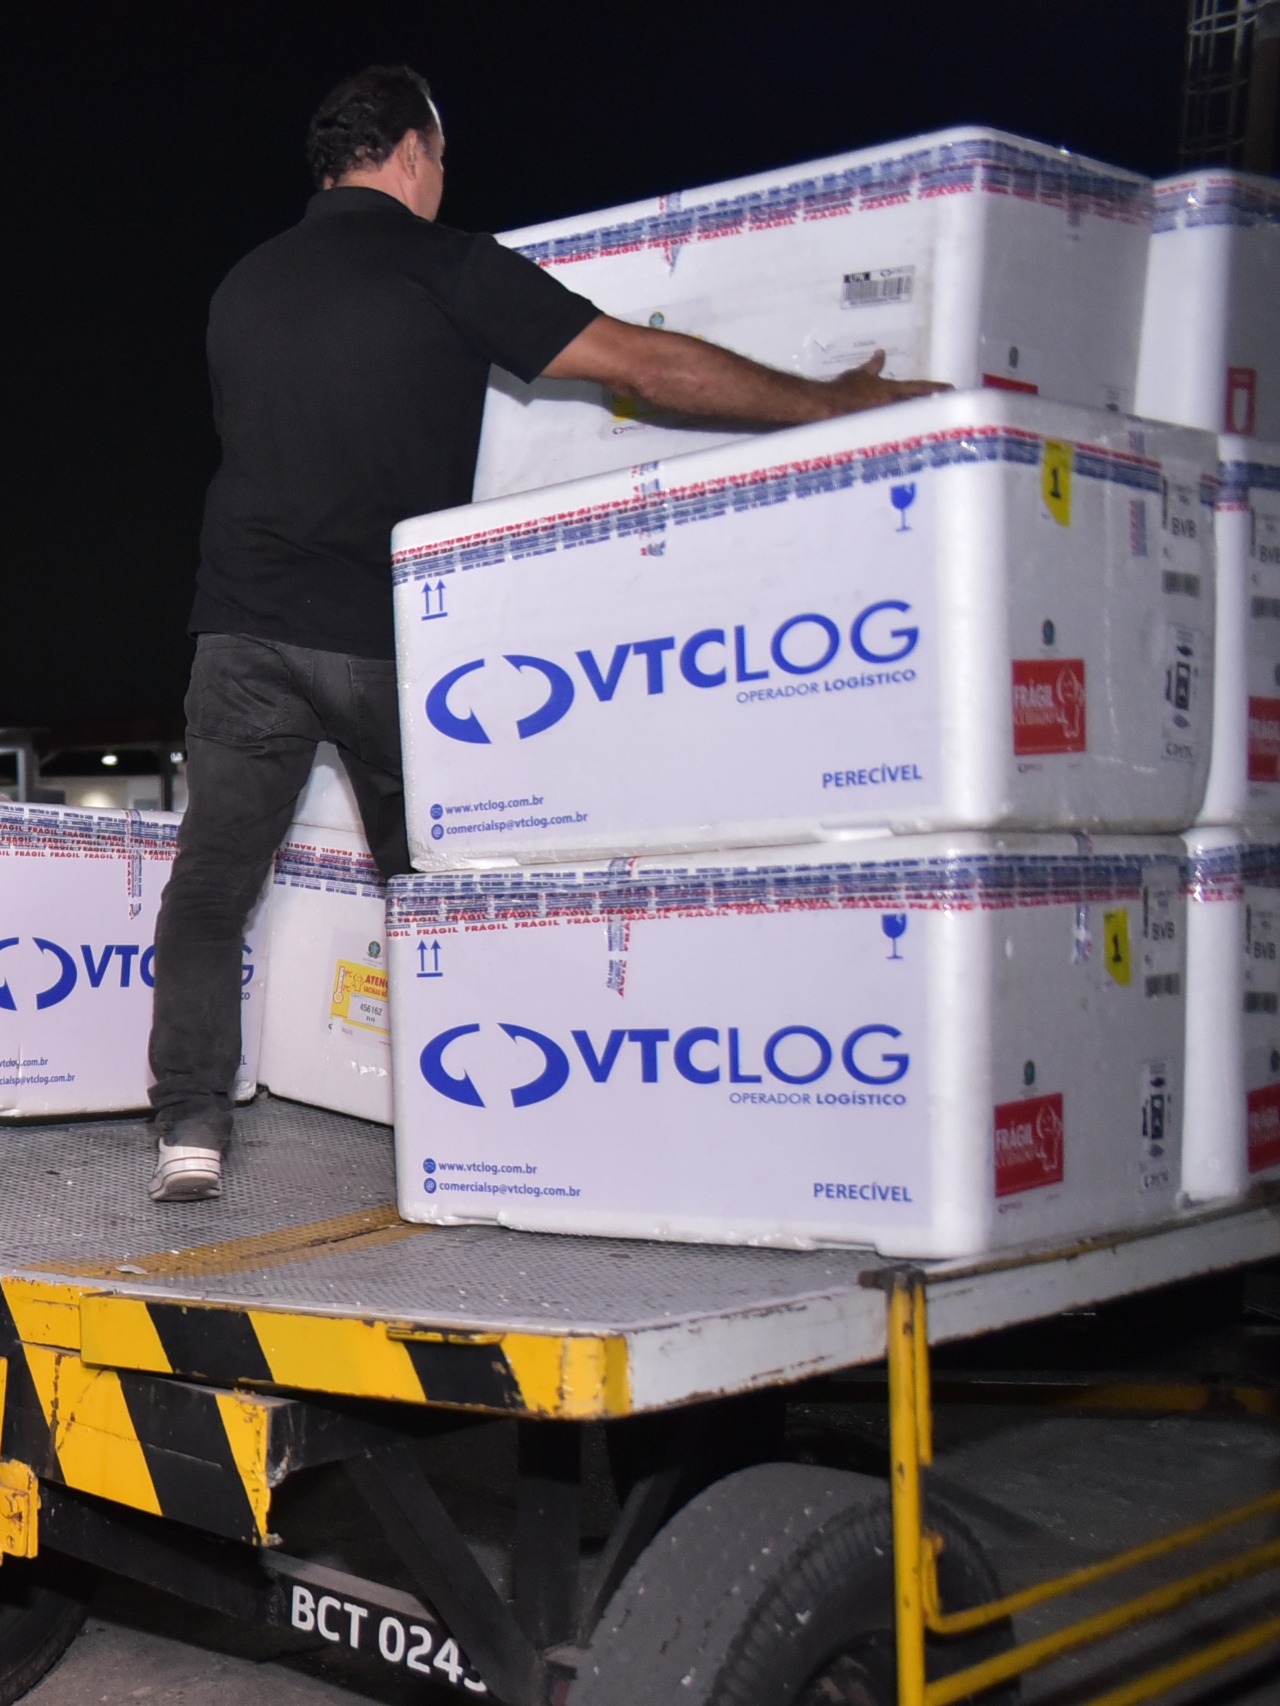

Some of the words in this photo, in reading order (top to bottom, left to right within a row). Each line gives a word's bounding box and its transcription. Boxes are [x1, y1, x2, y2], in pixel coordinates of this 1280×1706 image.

[1050, 468, 1063, 499] 1
[1172, 516, 1197, 539] BVB
[575, 599, 919, 703] VTCLOG
[736, 681, 820, 705] OPERADOR
[823, 668, 917, 694] LOGÍSTICO
[821, 762, 923, 790] PERECÍVEL
[445, 794, 545, 816] www.vtclog.com.br
[446, 811, 588, 837] comercialsp@vtclog.com.br
[15, 849, 46, 858] FRÁGIL
[50, 851, 81, 859] FRÁGIL
[84, 852, 114, 860] FRÁGIL
[285, 841, 317, 852] FRÁGIL
[320, 846, 353, 857] FRÁGIL
[416, 925, 458, 936] FRÁGIL
[464, 922, 508, 932] FRÁGIL
[514, 917, 560, 929] FRÁGIL
[1112, 933, 1123, 964] 1
[359, 1003, 383, 1016] 456162
[570, 1023, 911, 1086] VTCLOG
[729, 1091, 812, 1105] OPERADOR
[815, 1089, 907, 1106] LOGÍSTICO
[438, 1160, 538, 1175] www.vtclog.com.br
[439, 1179, 582, 1198] comercialsp@vtclog.com.br
[813, 1181, 913, 1203] PERECÍVEL
[291, 1585, 368, 1649] BCT
